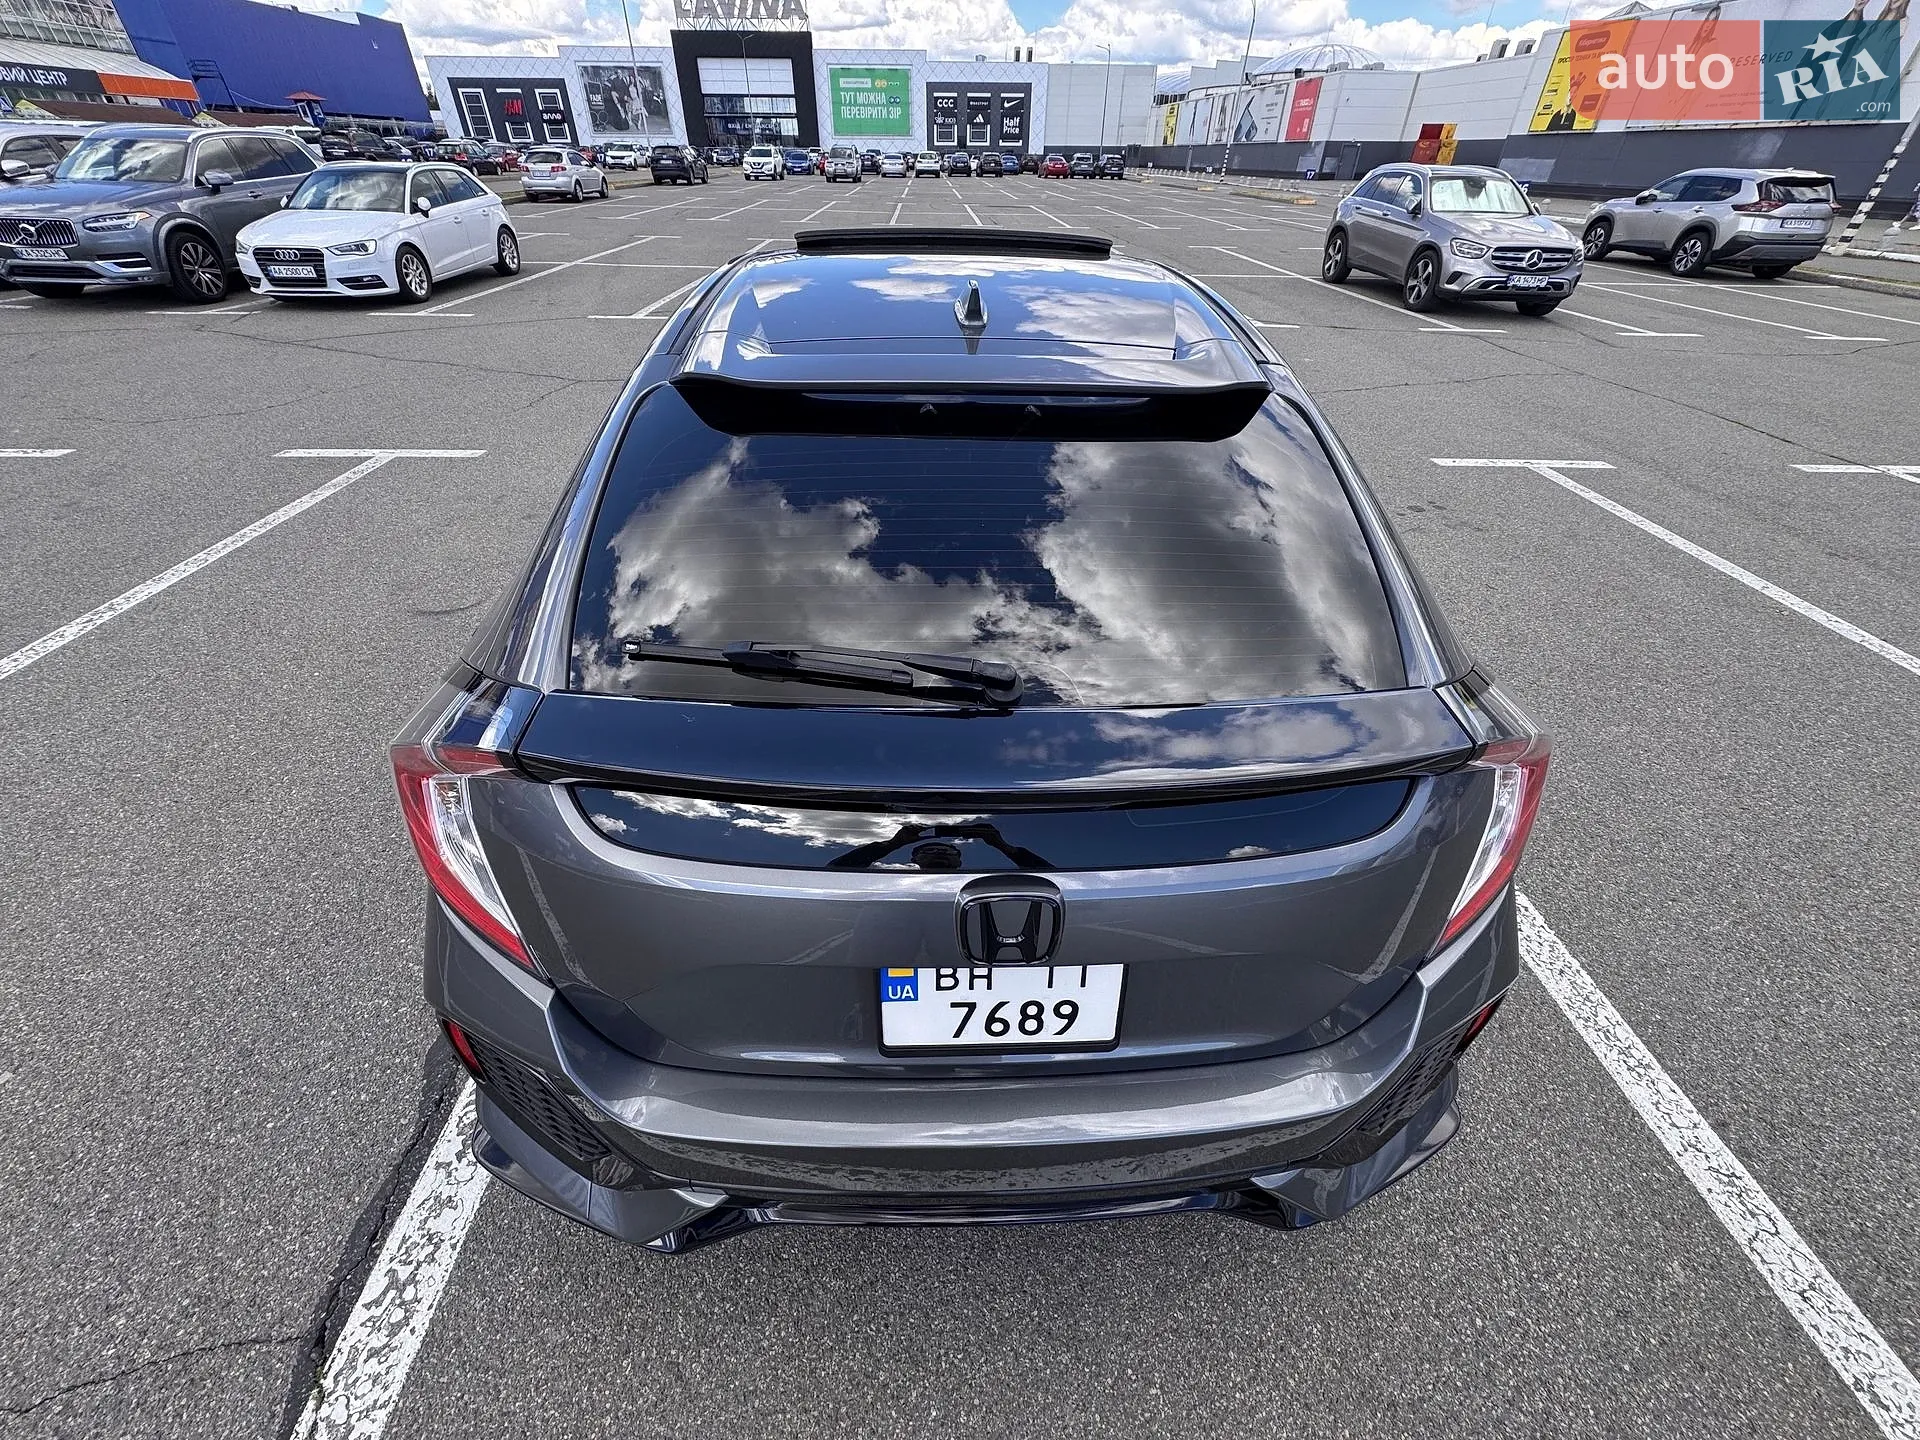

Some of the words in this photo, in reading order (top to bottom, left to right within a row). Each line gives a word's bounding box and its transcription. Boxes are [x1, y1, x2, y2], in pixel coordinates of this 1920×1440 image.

[28, 69, 68, 86] ЦЕНТР
[840, 92, 854, 104] ТУТ
[856, 92, 886, 104] МОЖНА
[937, 99, 954, 107] CCC
[841, 106, 888, 119] ПЕРЕВІРИТИ
[889, 106, 902, 119] ЗІР
[1003, 117, 1020, 126] Half
[935, 967, 992, 991] BH
[888, 985, 914, 999] UA
[950, 1000, 1079, 1038] 7689
